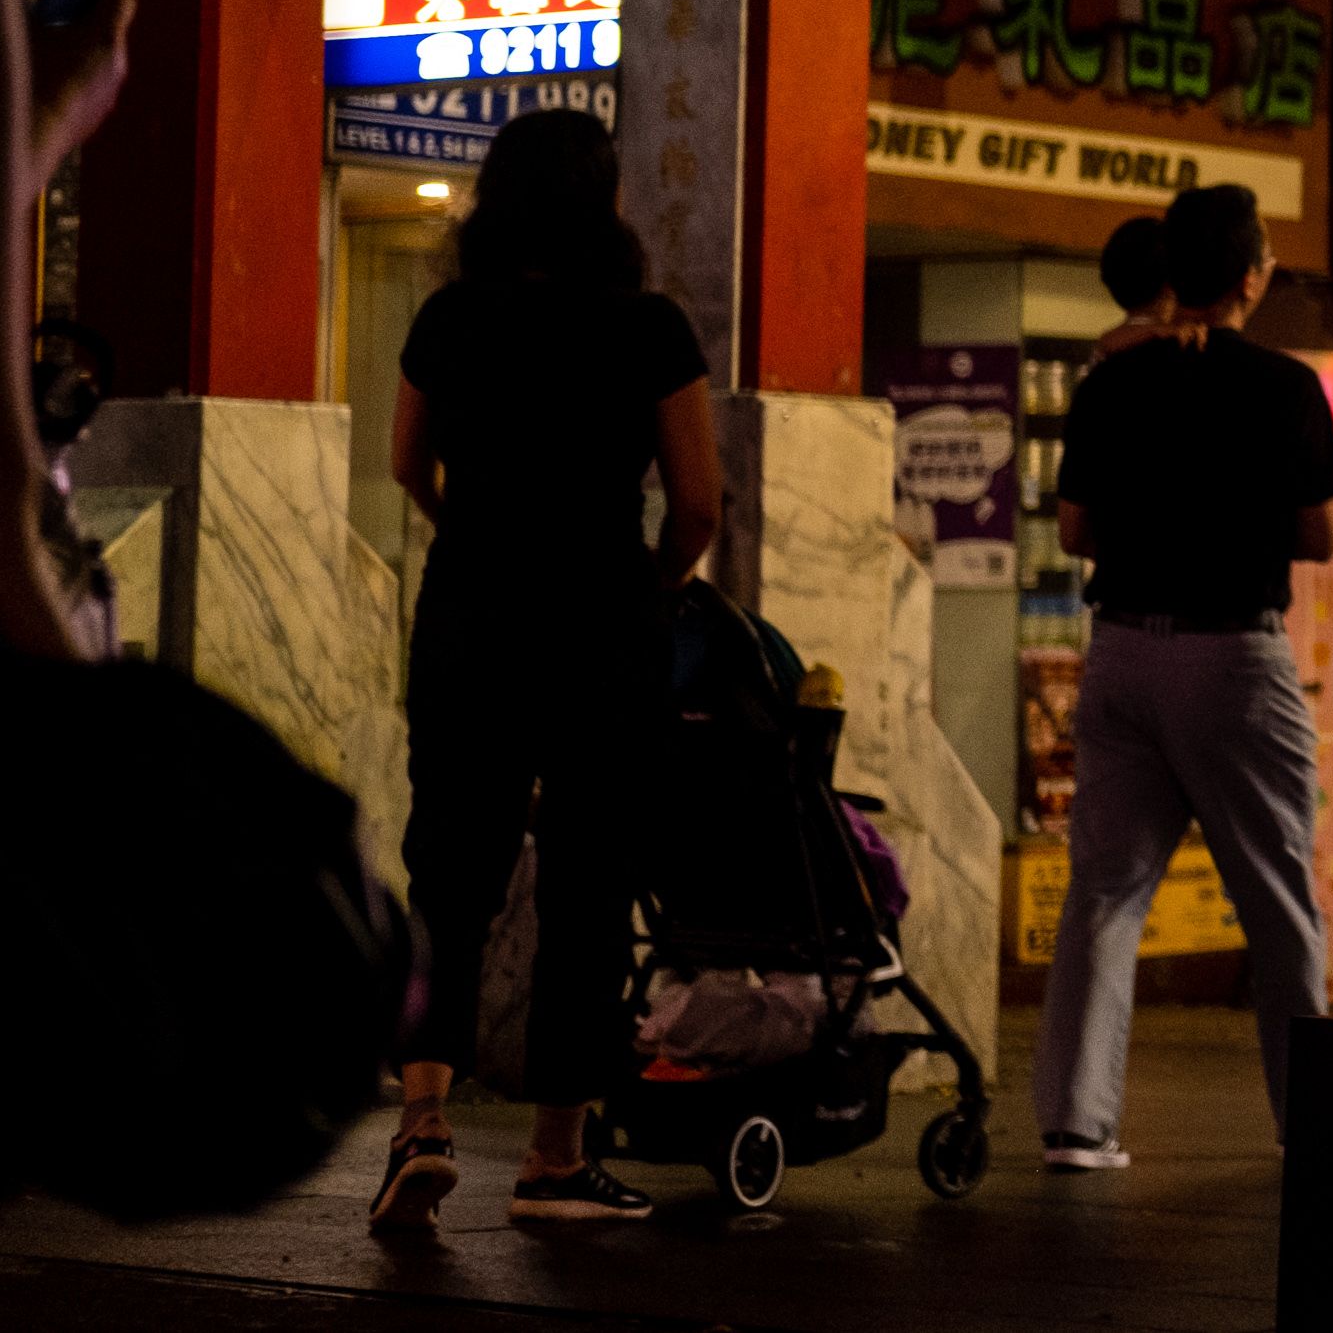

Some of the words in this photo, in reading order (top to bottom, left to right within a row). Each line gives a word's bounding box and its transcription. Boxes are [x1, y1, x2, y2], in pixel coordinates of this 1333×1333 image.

[480, 22, 581, 74] 9211
[977, 134, 1066, 178] GIFT
[1078, 145, 1200, 190] WORLD
